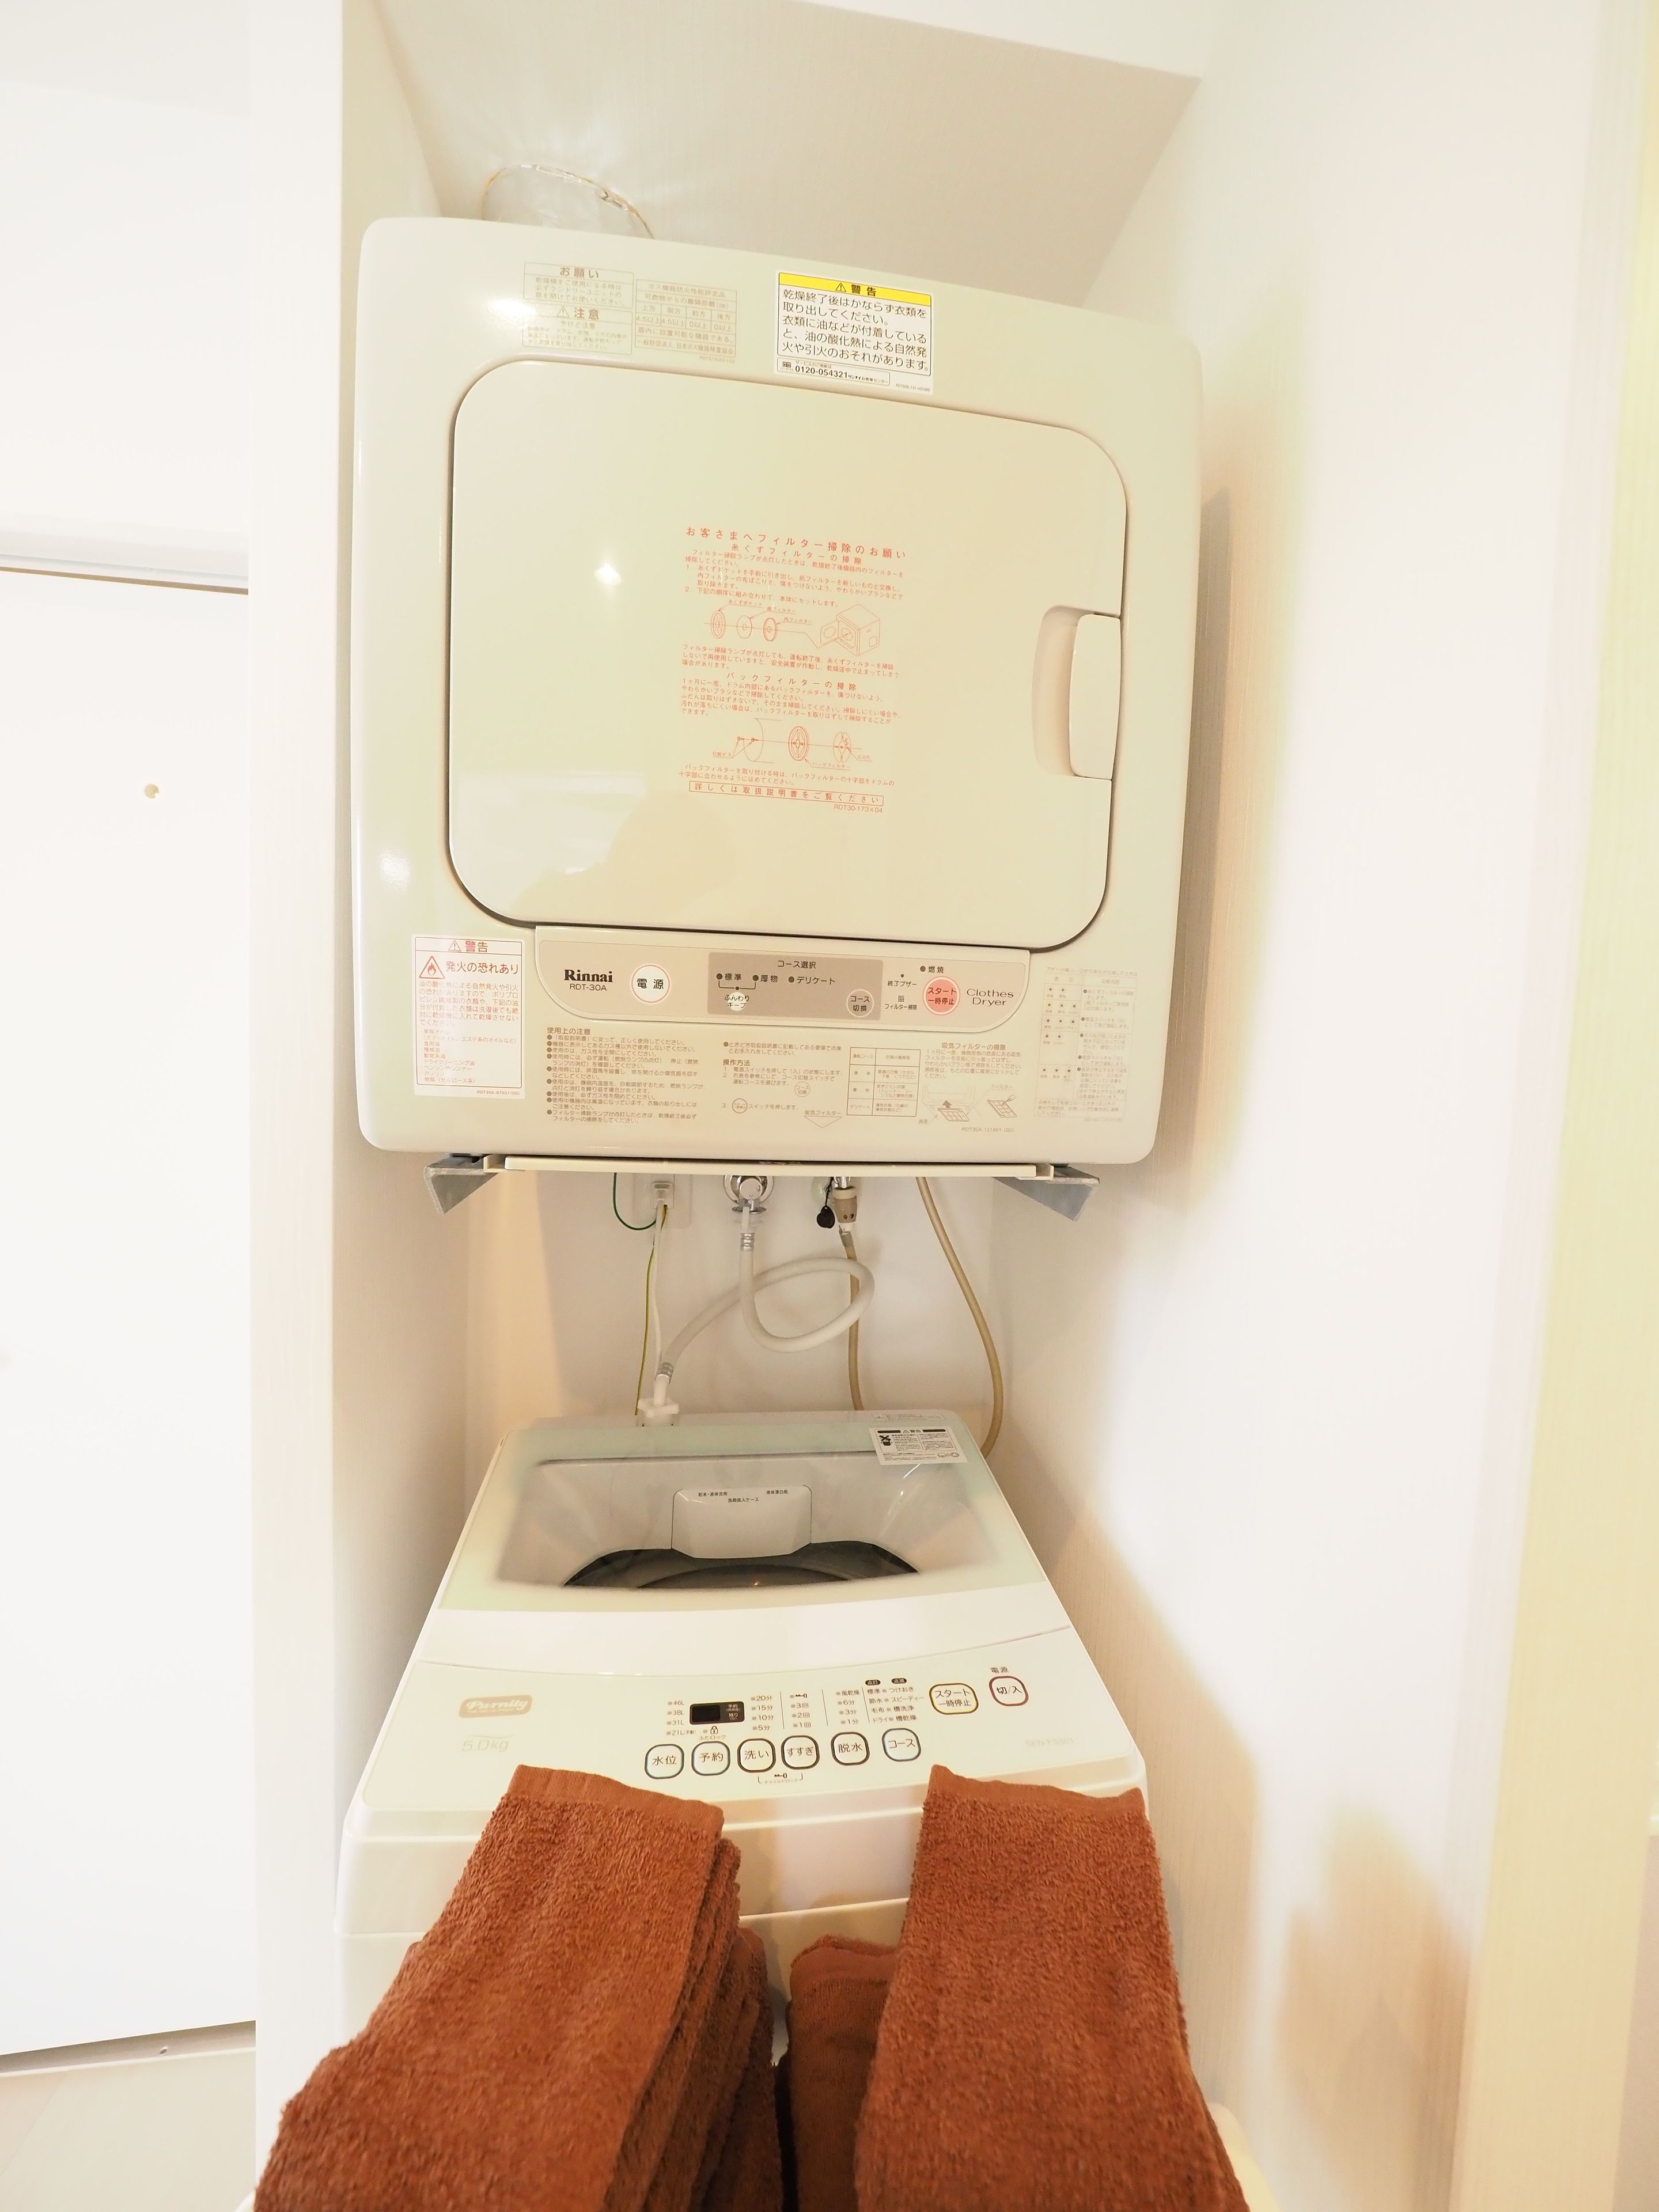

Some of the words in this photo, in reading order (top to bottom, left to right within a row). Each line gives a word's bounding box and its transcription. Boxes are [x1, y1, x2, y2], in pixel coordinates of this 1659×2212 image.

[560, 267, 599, 278] お願い
[536, 285, 622, 297] 必ずランドリーユニットの
[851, 284, 876, 297] 警告
[783, 289, 927, 319] 乾燥終了後はかならず衣類を
[574, 308, 599, 320] 注意
[783, 301, 888, 325] 取り出してください。
[783, 316, 927, 344] 衣類に油などが付着している
[783, 328, 927, 357] と、油の酸化熱による自然発
[782, 342, 928, 371] 火や引火のおそれがあります。
[795, 365, 848, 378] 0120-054321
[687, 527, 905, 559] お客さまへフィルター掃除のお願い
[732, 543, 862, 565] 糸くずフィルターの掃除
[685, 556, 738, 567] 掃除してください。
[698, 579, 738, 589] 取り除きます。
[682, 659, 729, 669] 場合があります。
[727, 672, 857, 691] バックフィルターの掃除
[682, 685, 803, 701] やわらかいブラシなどで掃除してください。
[679, 771, 794, 785] 十字部に合わせるようにはめてください。
[695, 783, 878, 803] 詳しくは取扱説明書をご覧ください
[465, 941, 488, 952] 警告
[446, 961, 518, 975] 発火の恐れあり
[778, 960, 816, 969] コース選択
[564, 969, 613, 983] Rinnai
[725, 973, 741, 981] 標準
[760, 975, 778, 983] 厚物
[797, 976, 835, 985] デリケート
[570, 983, 607, 991] RDT-30A
[637, 978, 664, 990] 電源
[927, 987, 957, 995] スタート
[967, 988, 1014, 998] Clothes
[972, 997, 1007, 1007] Dryer
[547, 1027, 590, 1035] 使用上の注意
[942, 1042, 1006, 1051] 吸気フィルターの掃除
[935, 1689, 971, 1699] スタート
[996, 1686, 1022, 1695] 切/入
[938, 1699, 971, 1707] 一時停止
[462, 1740, 509, 1752] 5.0kg
[838, 1743, 862, 1753] 脱水
[888, 1738, 915, 1749] コース
[744, 1750, 769, 1760] 洗い
[787, 1746, 813, 1756] すすぎ
[652, 1755, 677, 1766] 水位
[699, 1752, 724, 1763] 予約
